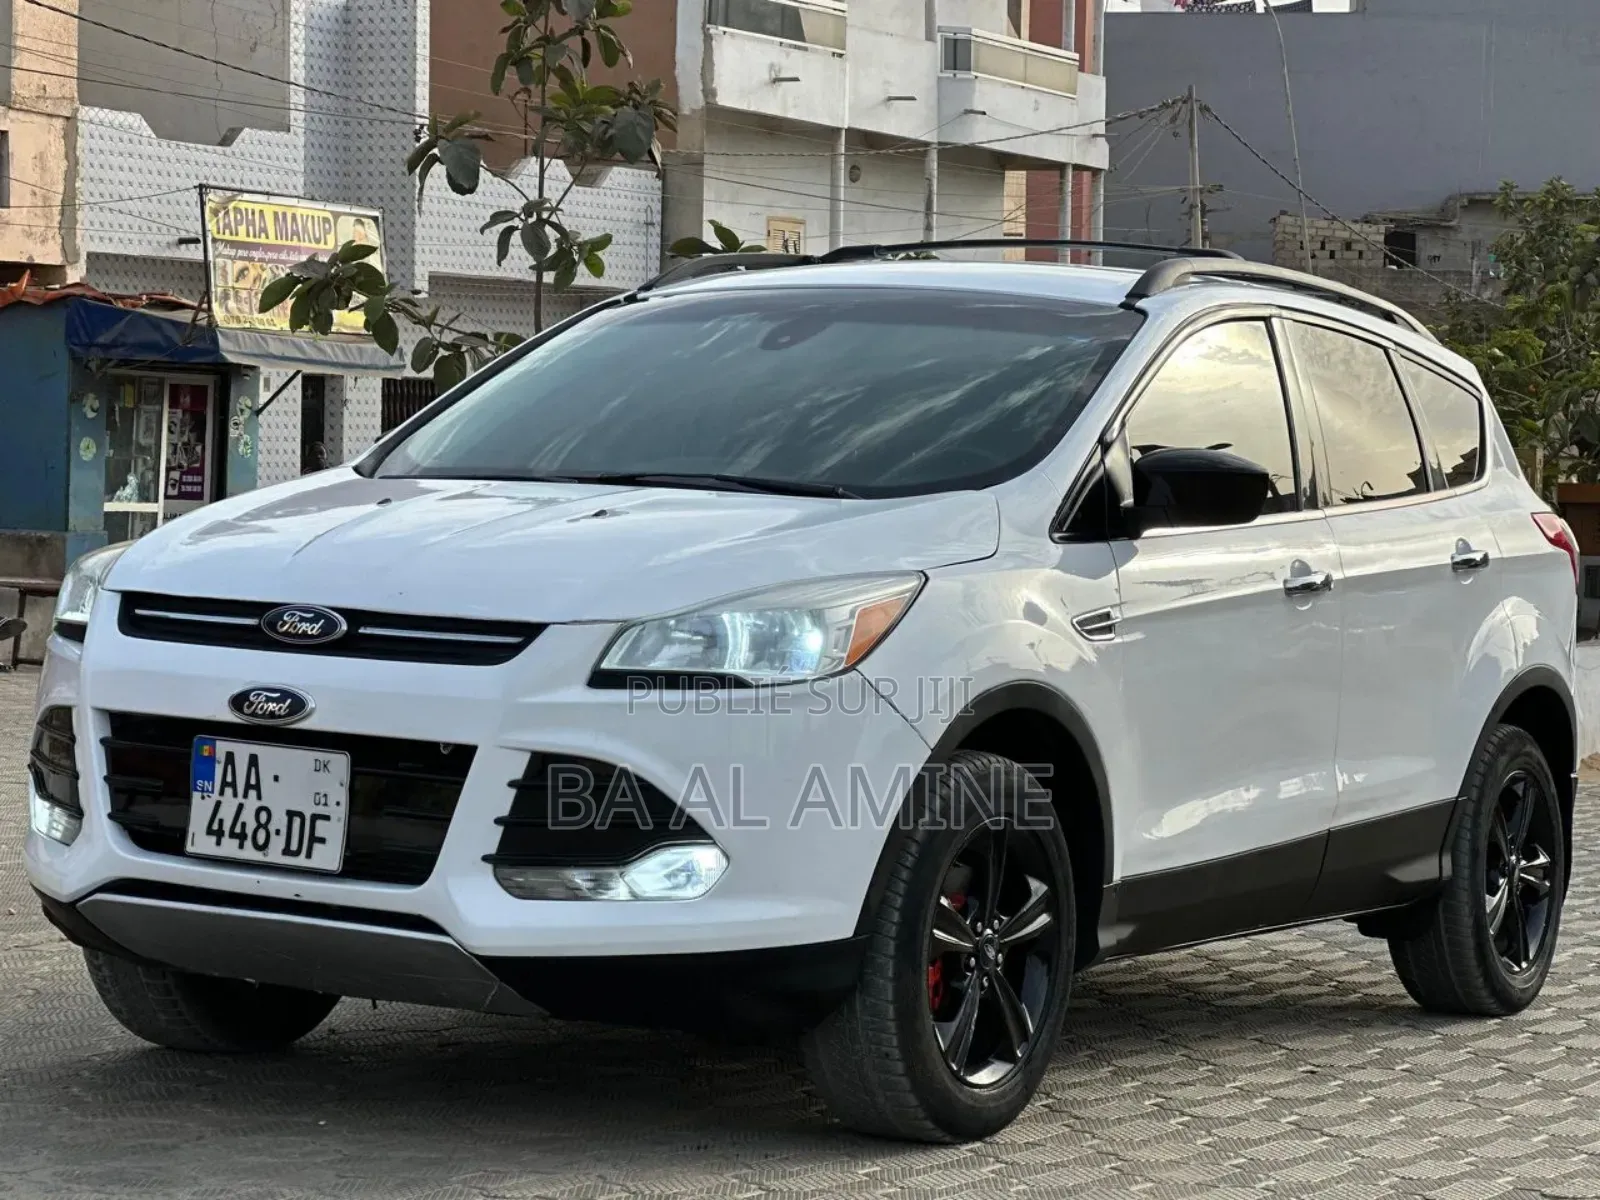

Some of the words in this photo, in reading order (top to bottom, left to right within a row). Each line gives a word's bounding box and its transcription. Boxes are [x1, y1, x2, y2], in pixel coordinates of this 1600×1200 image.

[273, 211, 332, 245] MAKUP
[277, 610, 322, 636] Ford
[243, 690, 292, 716] Ford
[313, 758, 331, 774] DK
[196, 780, 213, 792] SN
[313, 792, 329, 807] 01
